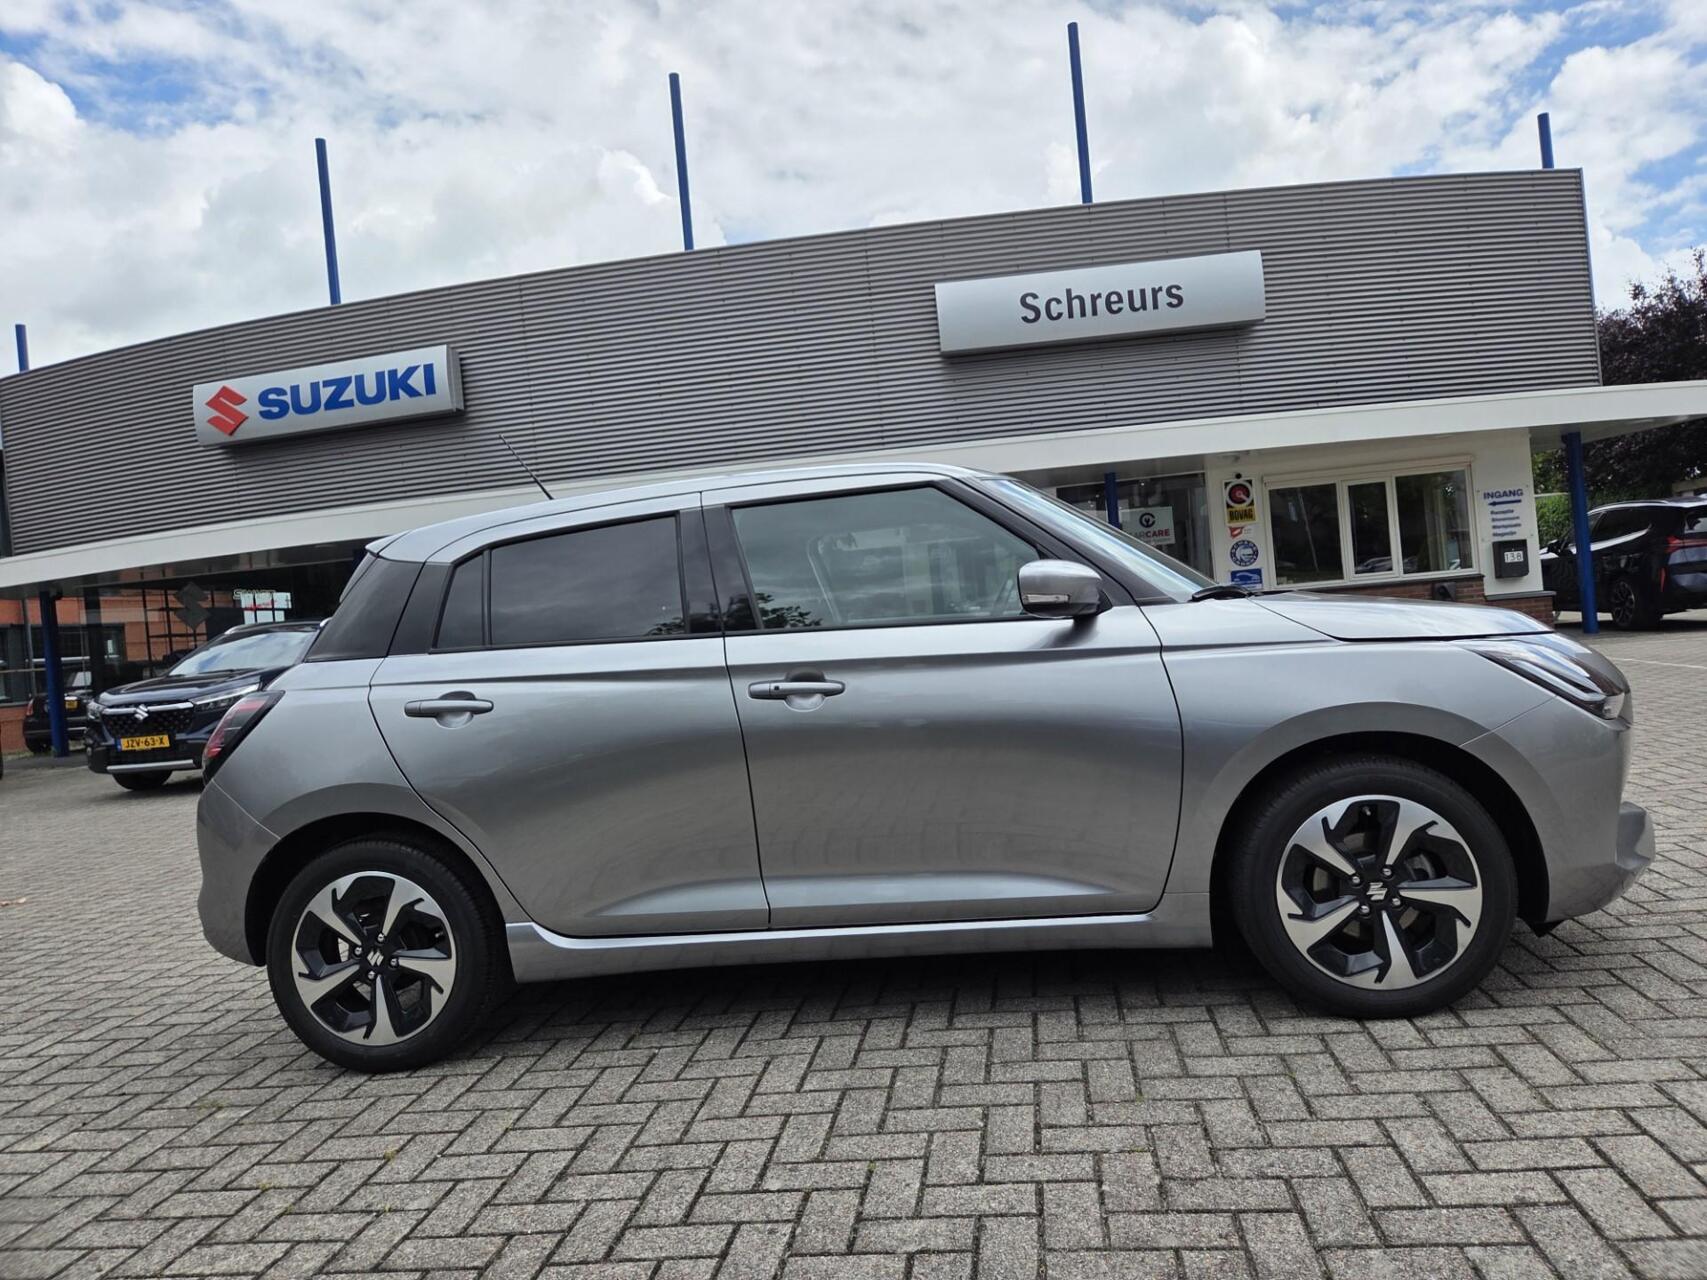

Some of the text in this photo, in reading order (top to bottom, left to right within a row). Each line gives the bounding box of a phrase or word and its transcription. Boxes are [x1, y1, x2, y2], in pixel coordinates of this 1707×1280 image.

[1020, 284, 1184, 324] Schreurs
[258, 363, 436, 421] SUZUKI
[1483, 488, 1524, 500] INGANG
[1229, 508, 1254, 521] BOVAG
